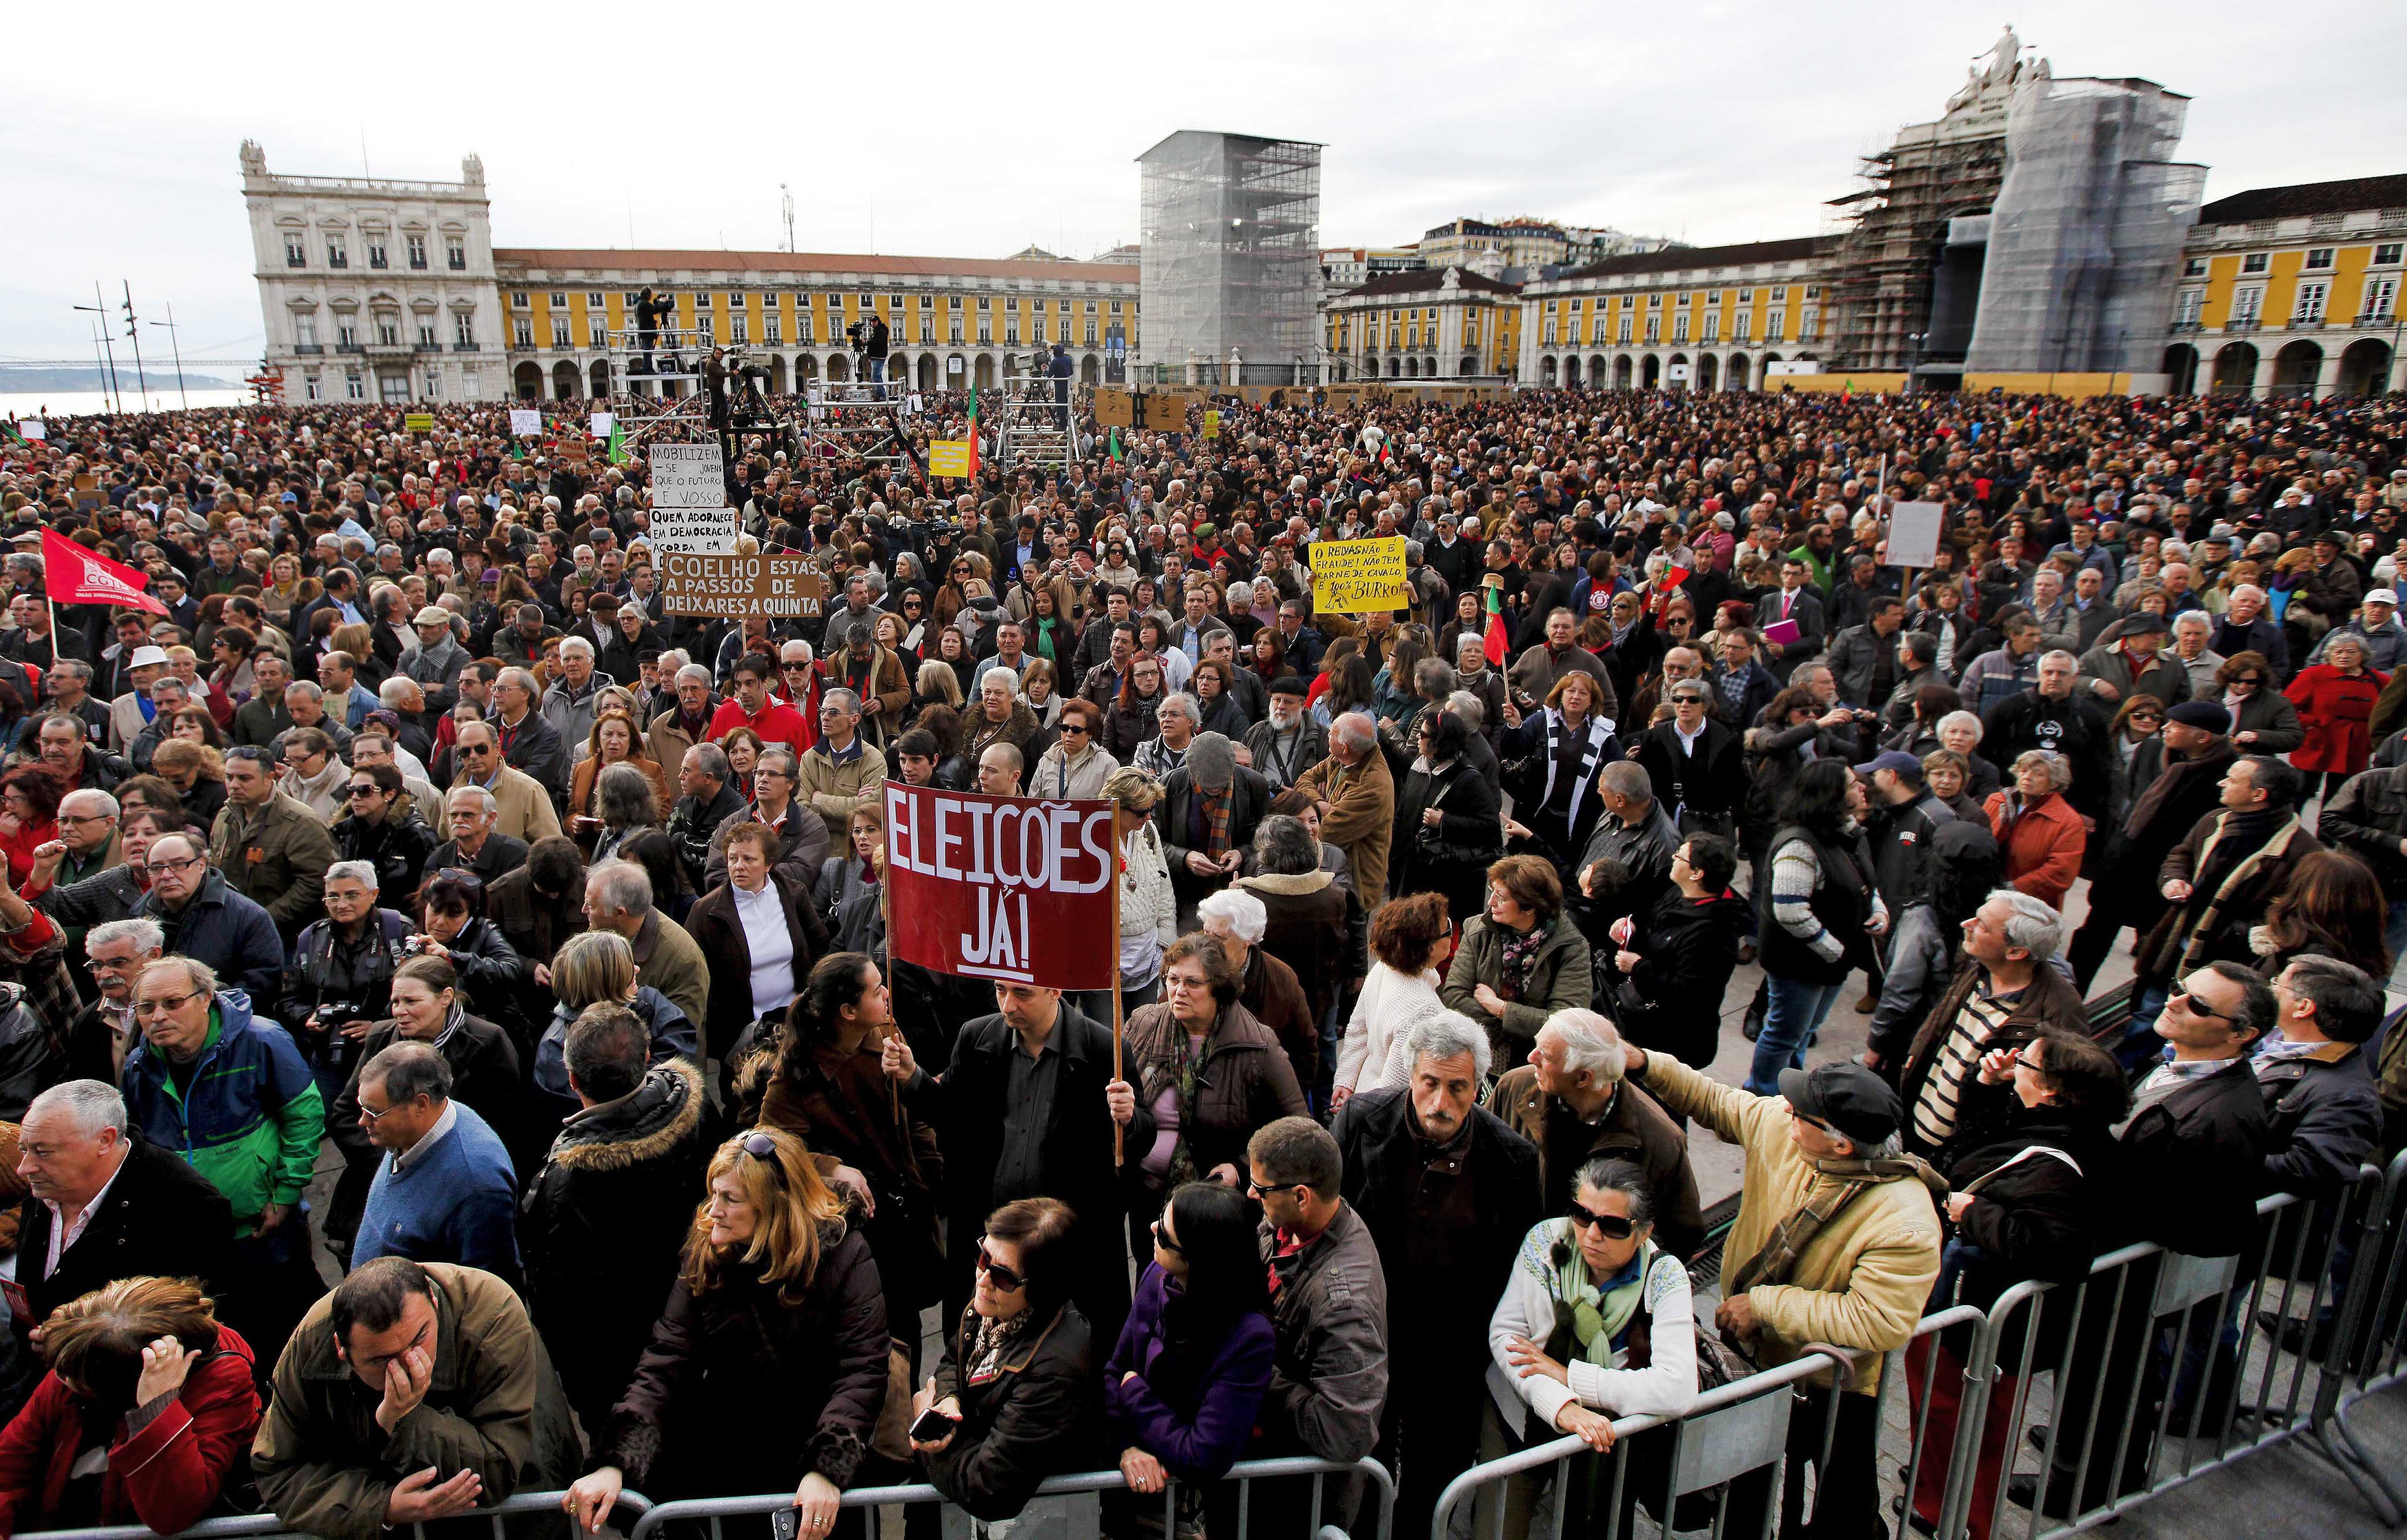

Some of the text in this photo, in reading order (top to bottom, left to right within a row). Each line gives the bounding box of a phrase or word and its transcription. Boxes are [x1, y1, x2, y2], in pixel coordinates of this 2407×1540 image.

[562, 442, 584, 450] FALTA
[652, 447, 720, 460] MOBILIZEM
[700, 464, 722, 474] JOVENS
[655, 475, 672, 487] QUE
[688, 477, 721, 485] FUTURO
[663, 487, 722, 504] É VOSSO
[652, 511, 733, 525] QUEM ADORMECE
[653, 526, 732, 539] EM DEMOCRACIA
[653, 540, 720, 553] ACORDA EM
[1315, 539, 1397, 559] O RELVAS NÃO É
[1363, 554, 1380, 566] NÃO
[1382, 555, 1400, 564] TEM
[668, 556, 760, 578] COELHO
[1318, 568, 1402, 579] CARNE DE CAVALO,
[665, 578, 796, 595] A PASSOS DE
[1318, 578, 1326, 590] É
[1330, 580, 1352, 590] 100%
[665, 593, 820, 617] DEIXARES A QUINTA
[887, 787, 1112, 894] ELEIÇÕES
[1900, 831, 1916, 842] NIKE
[961, 886, 1030, 969] JÁ!
